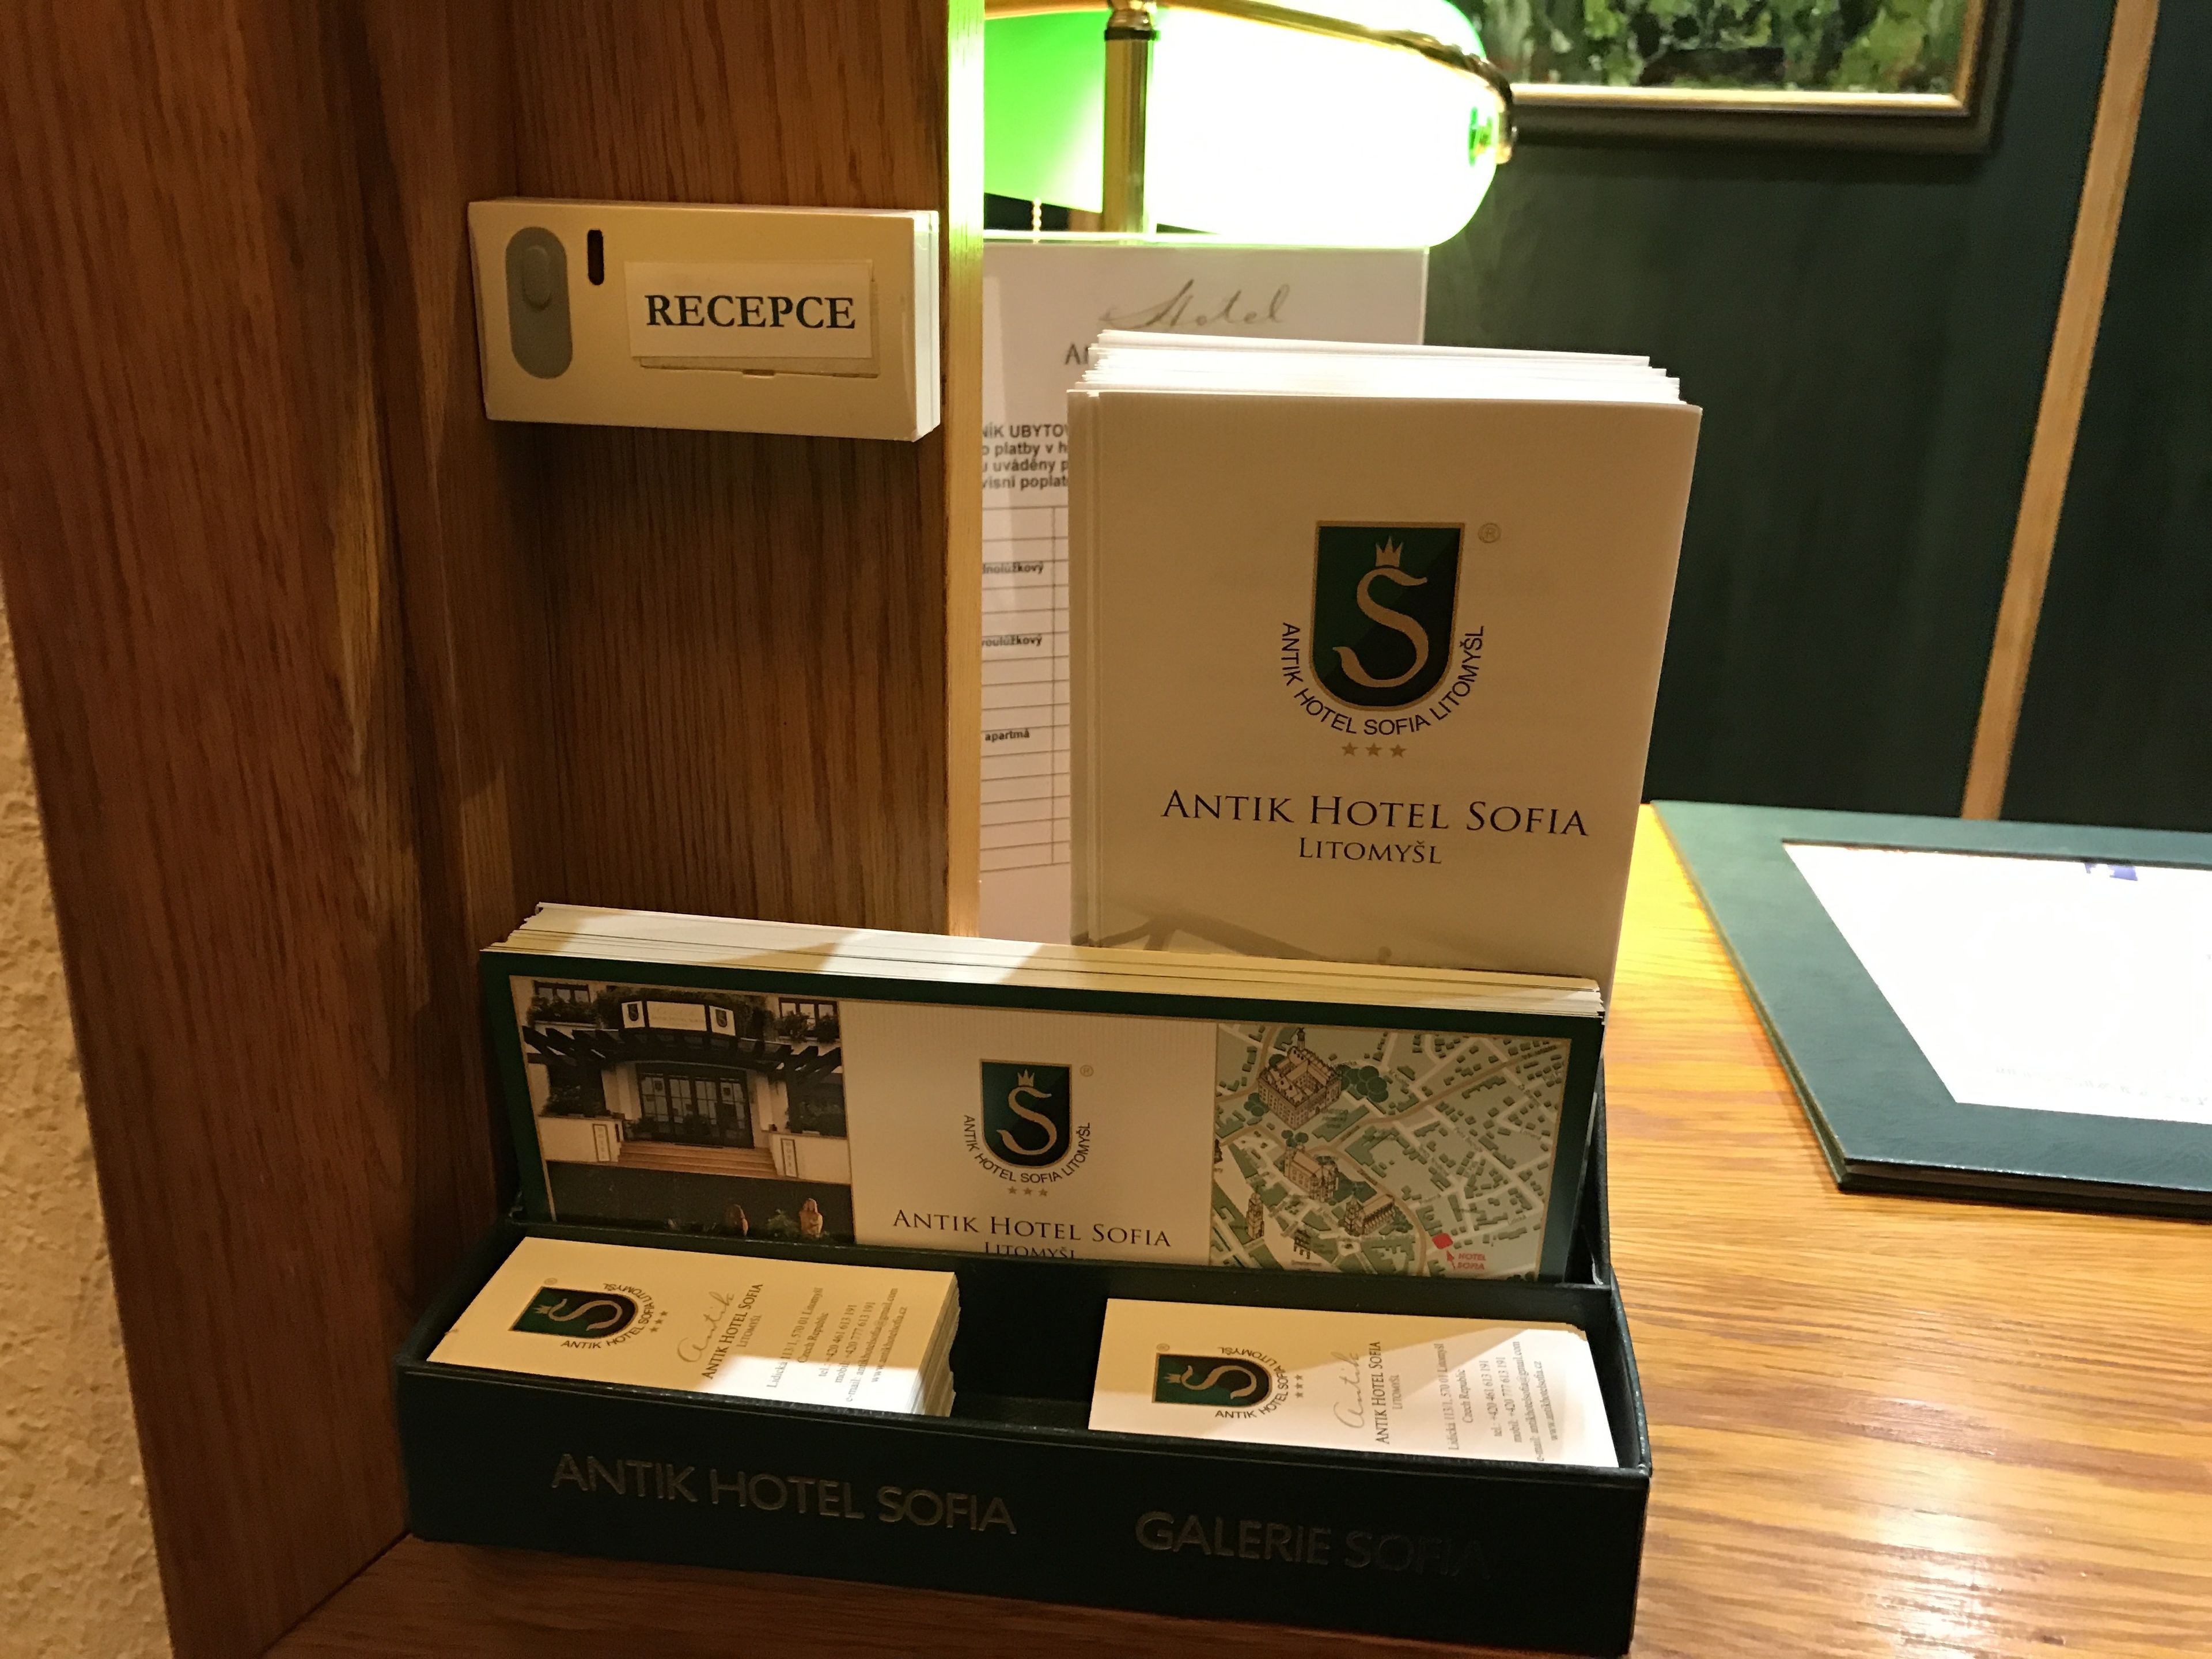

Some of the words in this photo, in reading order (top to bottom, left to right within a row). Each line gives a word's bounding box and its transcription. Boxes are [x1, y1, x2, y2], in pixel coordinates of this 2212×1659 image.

[644, 294, 856, 329] RECEPCE
[995, 442, 1040, 457] platby
[1045, 444, 1054, 453] v
[1010, 423, 1067, 438] UBYTO
[1281, 622, 1304, 687] ANTIK
[1294, 688, 1357, 734] HOTEL
[1363, 714, 1431, 736] SOFIA
[1429, 625, 1484, 721] LITOMYŠL
[1160, 789, 1294, 824] ANTIK
[1310, 795, 1449, 830] HOTEL
[1466, 800, 1589, 838] SOFIA
[1299, 837, 1442, 865] LITOMYŠL
[964, 1114, 980, 1152] ANTIK
[974, 1153, 1016, 1182] HOTEL
[1020, 1171, 1063, 1183] SOFIA
[1061, 1122, 1090, 1176] LITOMYŠL
[893, 1209, 979, 1233] ANTIK
[990, 1215, 1081, 1241] HOTEL
[1092, 1224, 1172, 1248] SOFIA
[560, 1340, 601, 1349] ANTIK
[606, 1325, 645, 1346] HOTEL
[638, 1301, 655, 1324] SOFIA
[701, 1346, 730, 1380] ANTIK
[718, 1312, 748, 1344] HOTEL
[738, 1283, 764, 1309] SOFIA
[797, 1342, 813, 1363] Czech
[807, 1312, 829, 1342] Republic
[1368, 1341, 1383, 1369] SOFIA
[1214, 1410, 1257, 1419] ANTIK
[1258, 1391, 1289, 1415] HOTEL
[1274, 1365, 1289, 1390] SOFIA
[1371, 1372, 1387, 1406] HOTEL
[1375, 1409, 1390, 1445] ANTIK
[551, 1452, 698, 1502] ANTIK
[710, 1468, 864, 1520] HOTEL
[878, 1484, 1017, 1535] SOFIA
[1135, 1510, 1332, 1566] GALERIE
